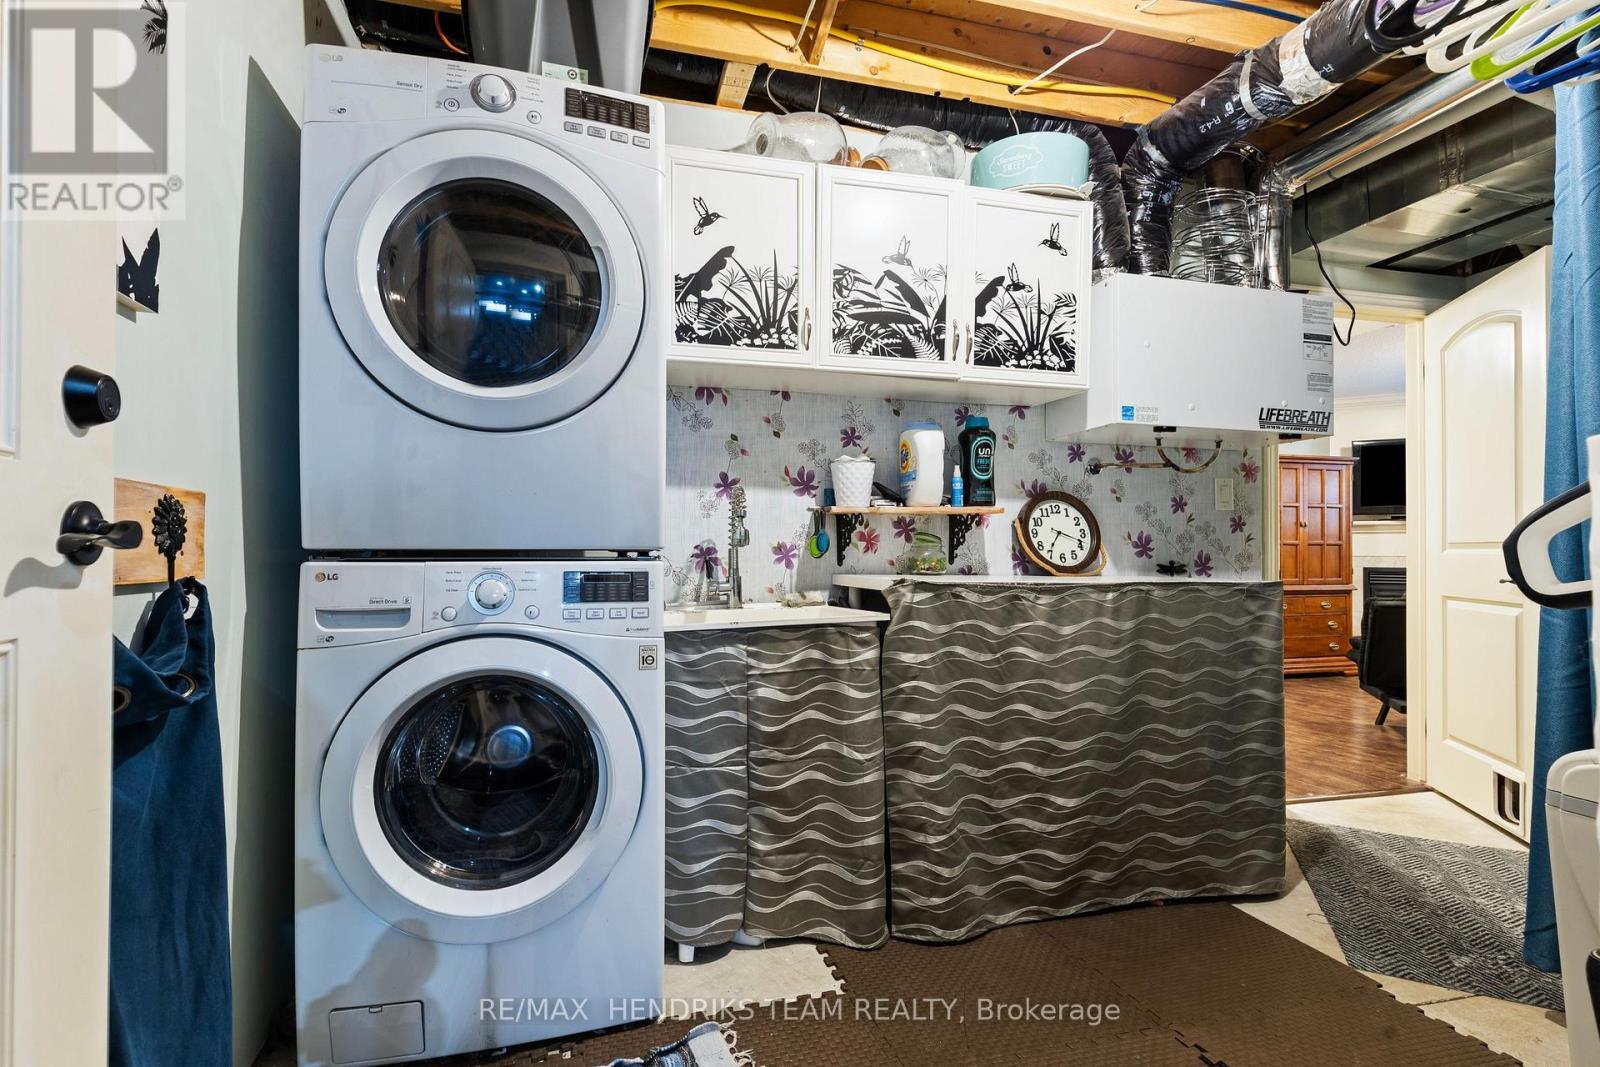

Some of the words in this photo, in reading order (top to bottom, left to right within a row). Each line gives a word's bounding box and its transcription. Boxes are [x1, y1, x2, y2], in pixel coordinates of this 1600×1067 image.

[1258, 408, 1331, 425] LIFEBREATH
[1039, 508, 1050, 517] 11
[1049, 504, 1061, 514] 12
[1063, 508, 1070, 517] 1
[1032, 517, 1043, 527] 10
[1073, 517, 1081, 526] 2
[1031, 528, 1038, 538] 9
[1079, 529, 1086, 539] 3
[1037, 541, 1044, 551] 8
[1077, 540, 1084, 551] 4
[1047, 550, 1053, 560] 7
[1059, 553, 1067, 563] 6
[1070, 550, 1078, 560] 5
[327, 573, 339, 581] LG
[641, 655, 655, 666] 10
